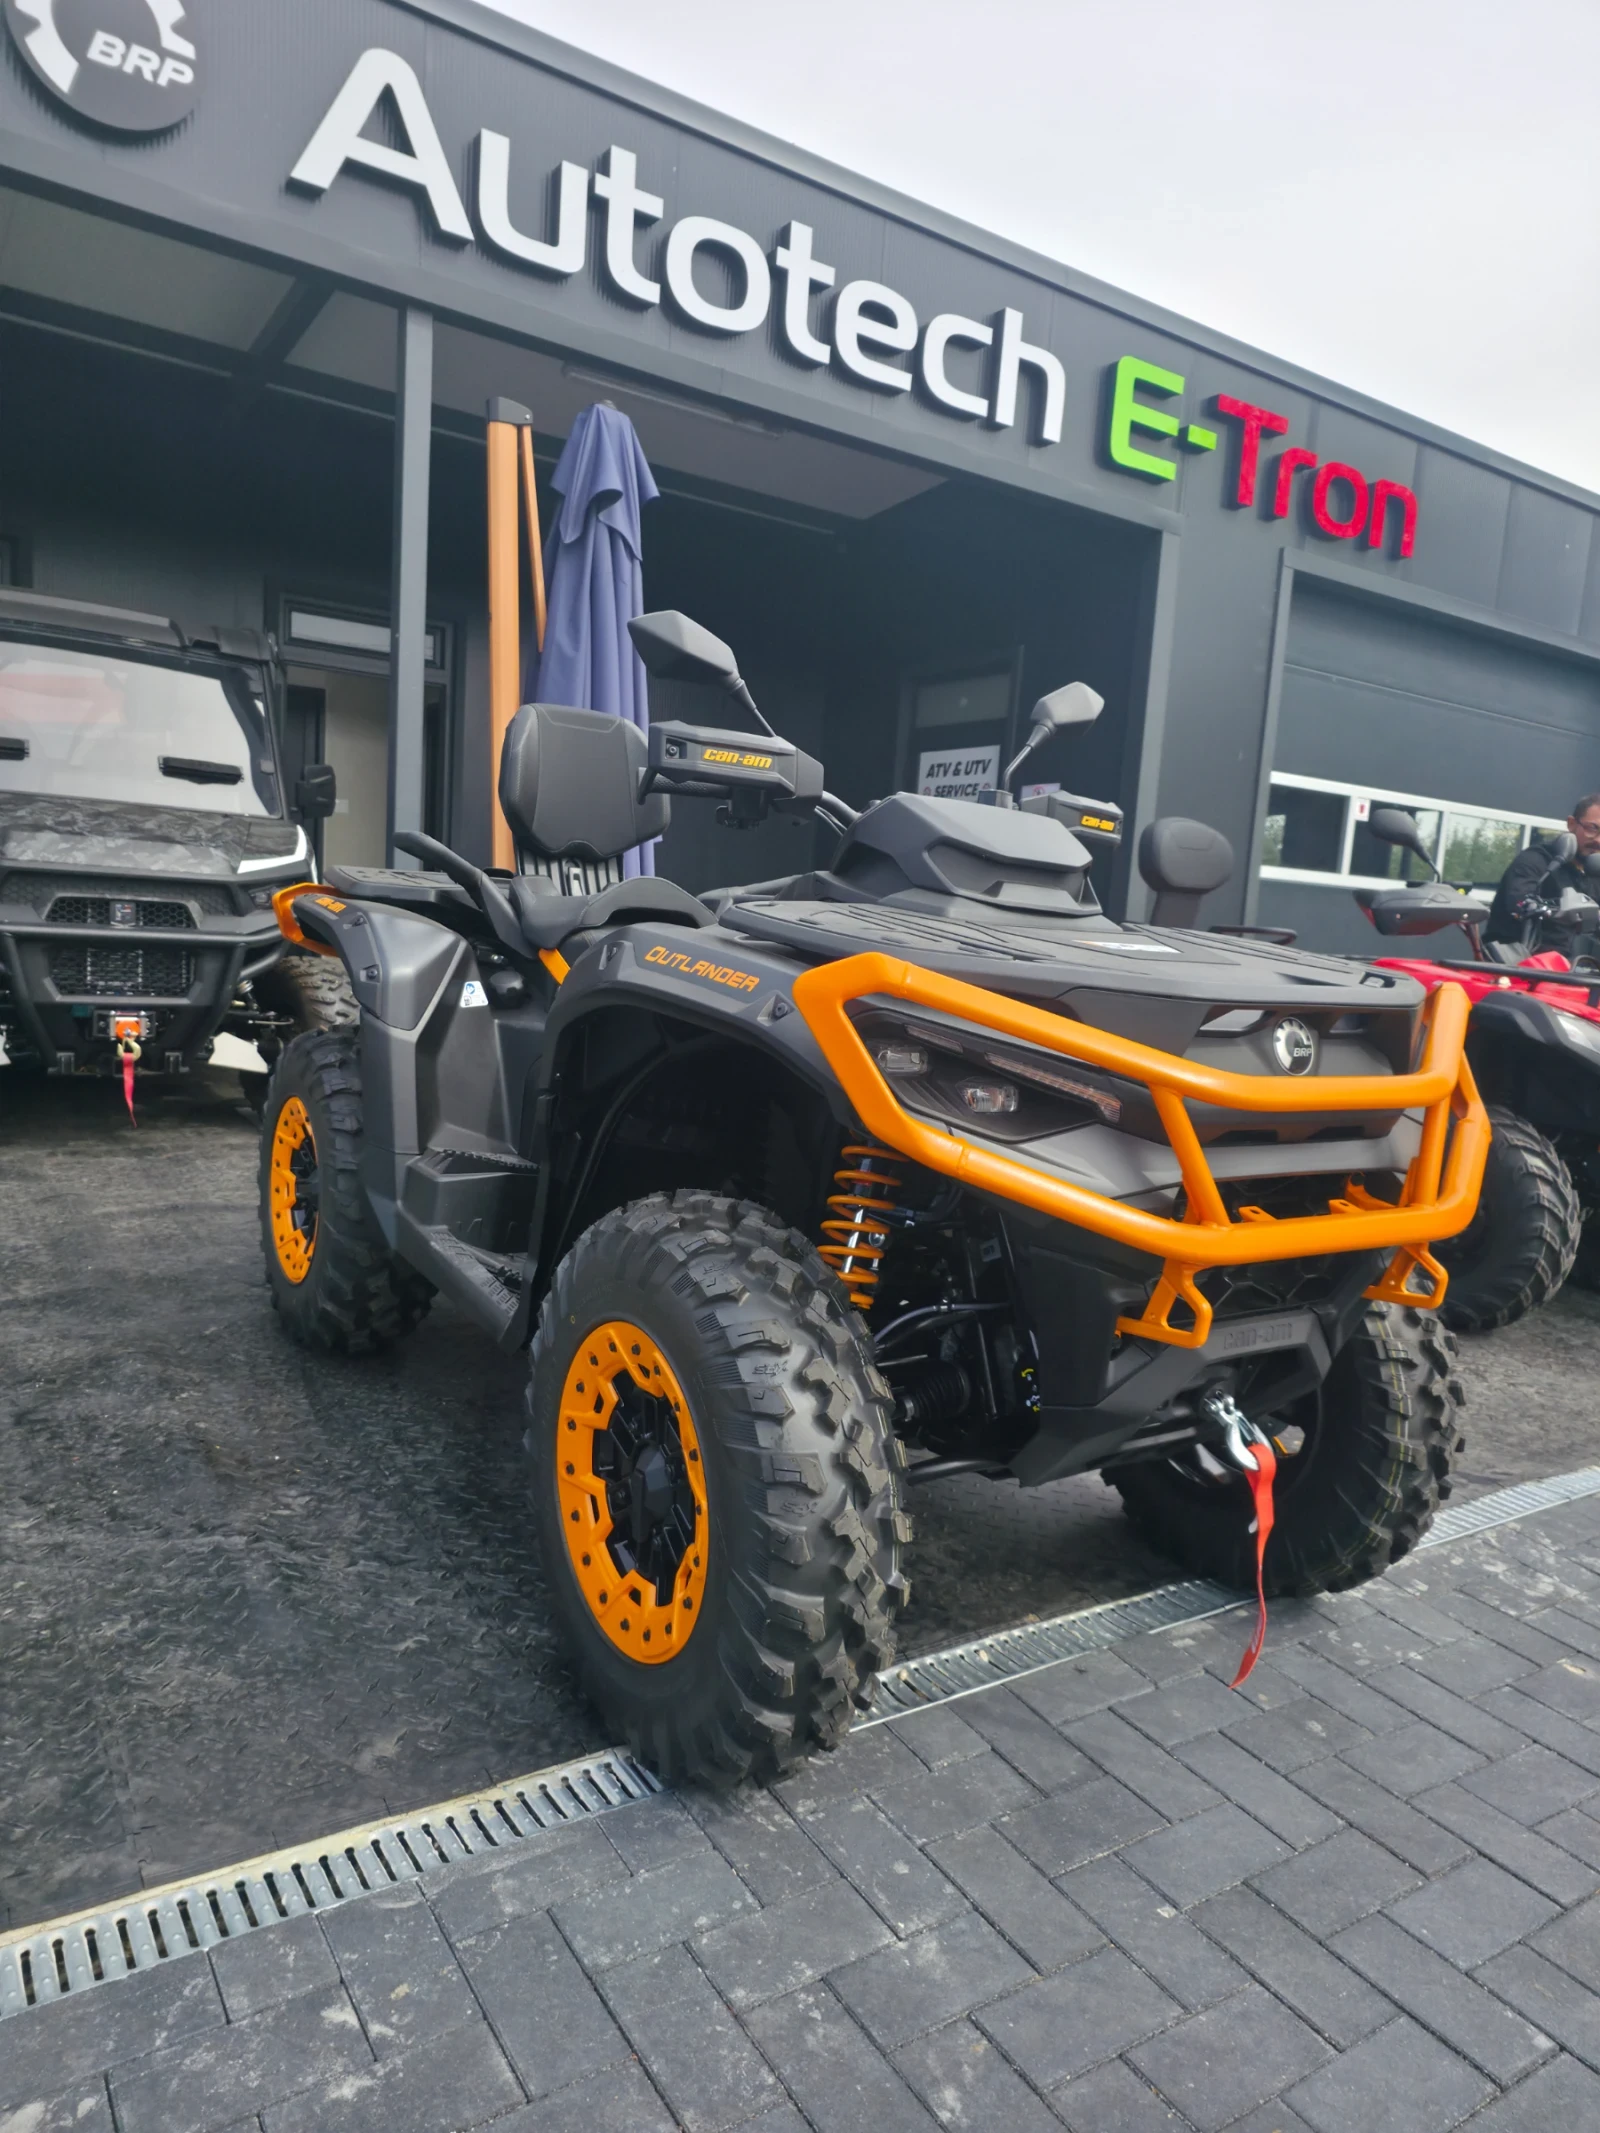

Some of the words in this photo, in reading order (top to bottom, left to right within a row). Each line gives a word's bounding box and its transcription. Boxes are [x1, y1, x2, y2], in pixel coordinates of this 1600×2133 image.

[86, 29, 195, 89] BRP
[289, 47, 1067, 445] Autotech
[1109, 354, 1418, 559] E-Tron
[703, 748, 773, 769] can-am
[926, 762, 952, 779] ATV
[953, 761, 963, 777] &
[964, 758, 992, 776] UTV
[934, 783, 979, 798] SERVICE
[644, 945, 760, 993] OUTLANDER
[1293, 1047, 1312, 1057] BRP
